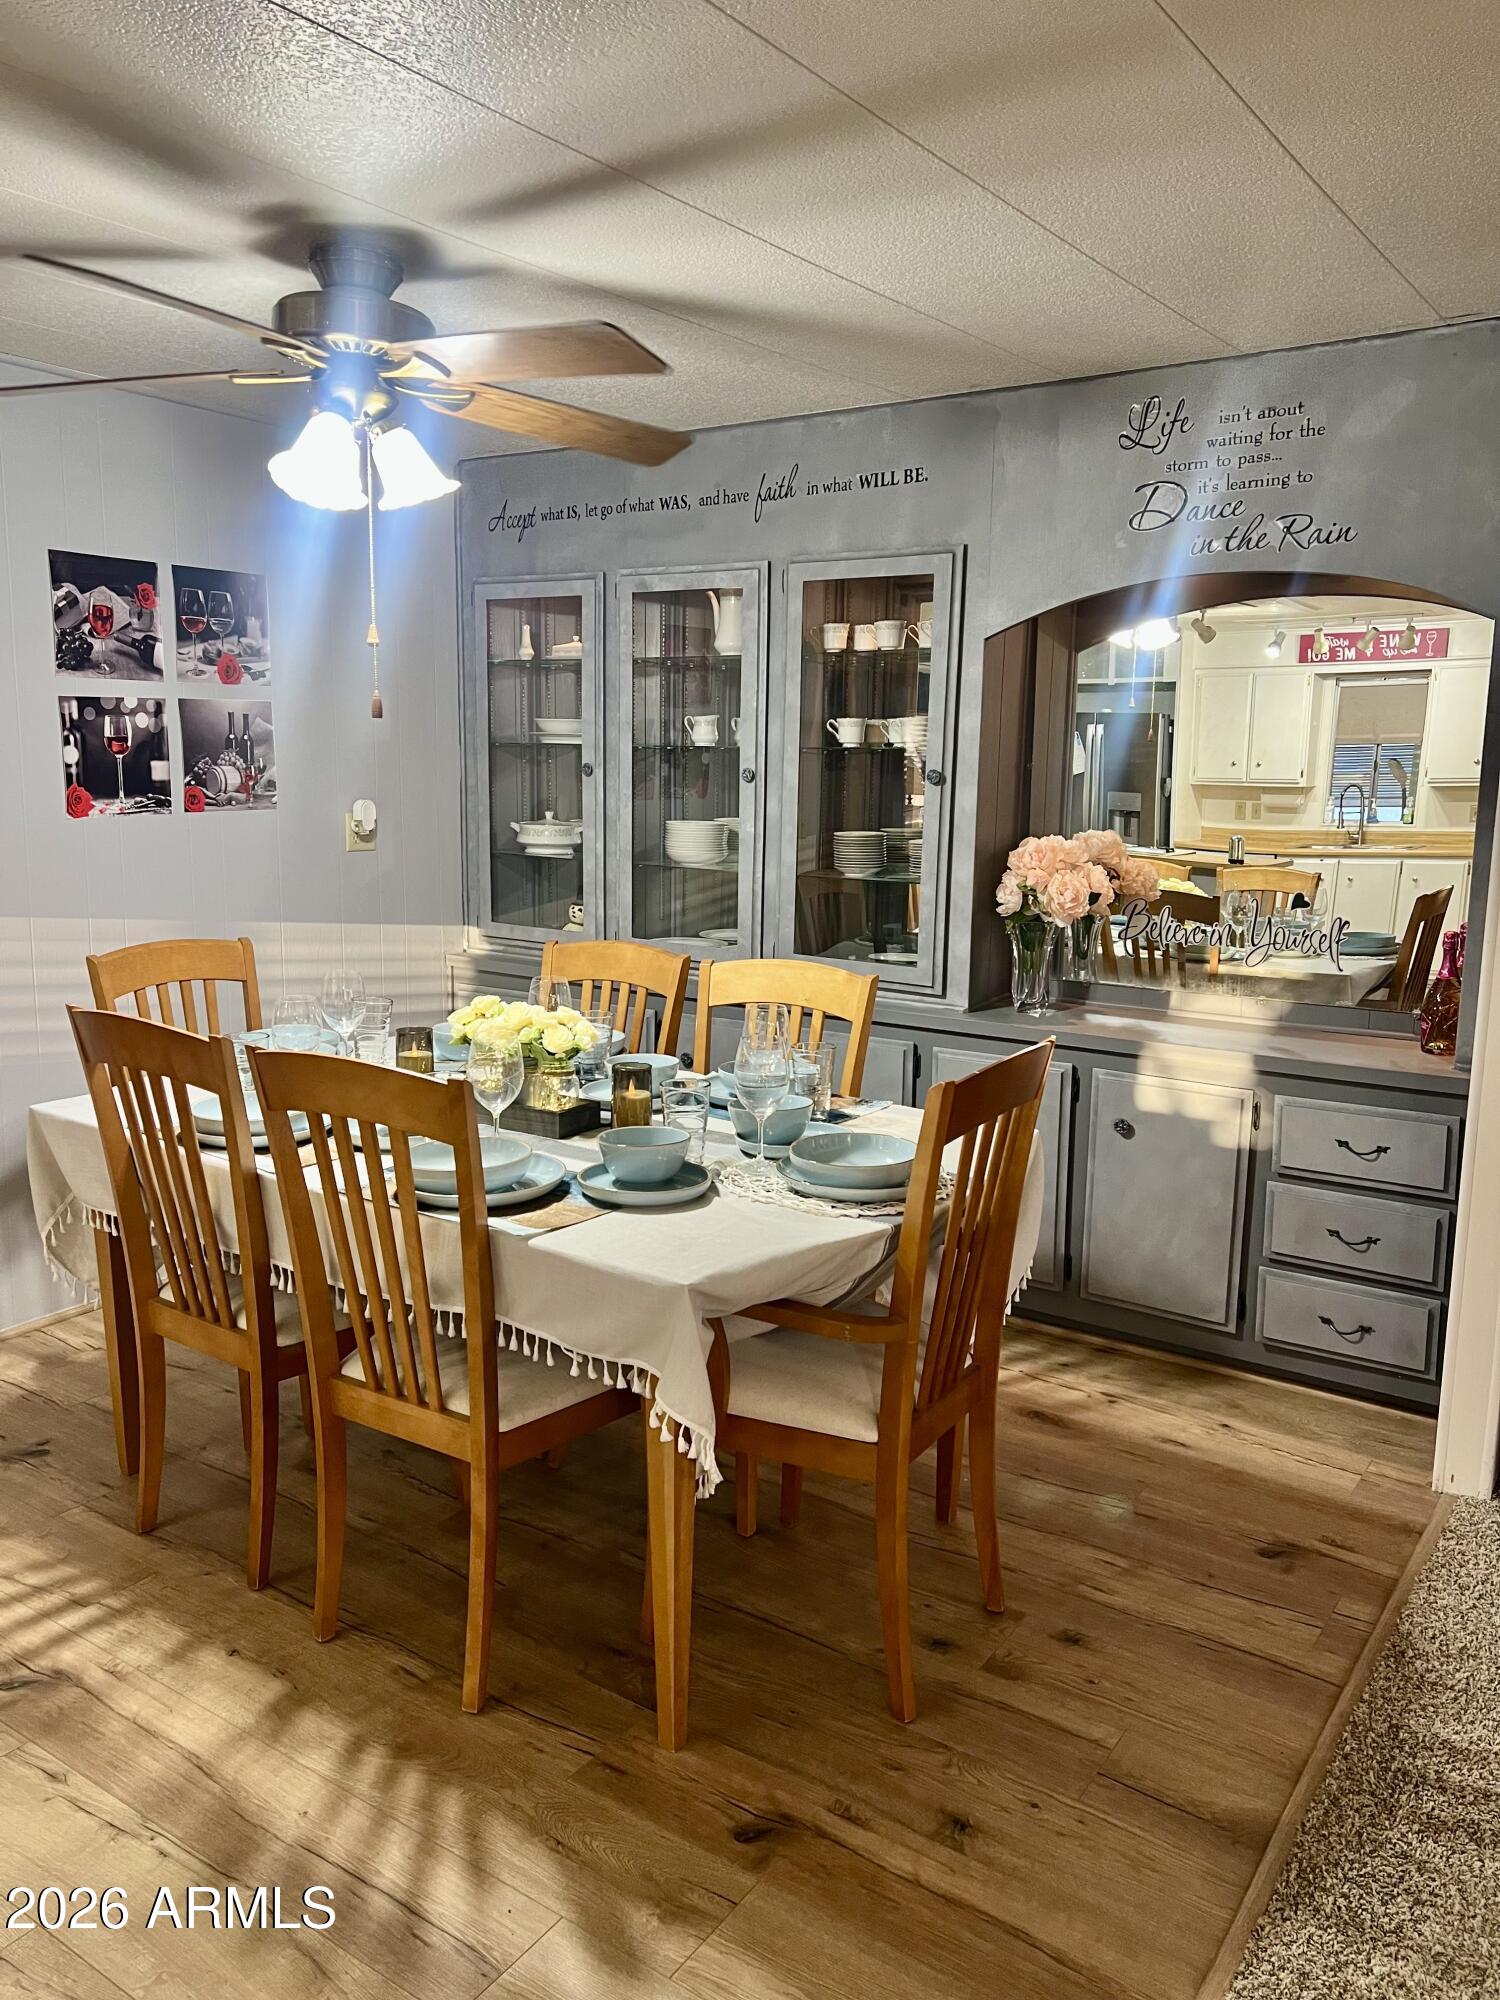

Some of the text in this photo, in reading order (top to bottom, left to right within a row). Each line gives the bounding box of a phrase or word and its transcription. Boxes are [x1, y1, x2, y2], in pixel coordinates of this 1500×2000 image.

[1118, 395, 1305, 455] Life isn't about
[1207, 417, 1326, 448] waiting for the
[1165, 453, 1283, 473] storm to pass...
[1198, 469, 1313, 495] it's learning to
[488, 463, 929, 543] Accept what IS, let go of what WAS, and have faith in what WILL BE.
[1128, 480, 1246, 532] Dance
[1190, 513, 1358, 556] in the Rain
[1118, 897, 1351, 973] Believe in Yourself
